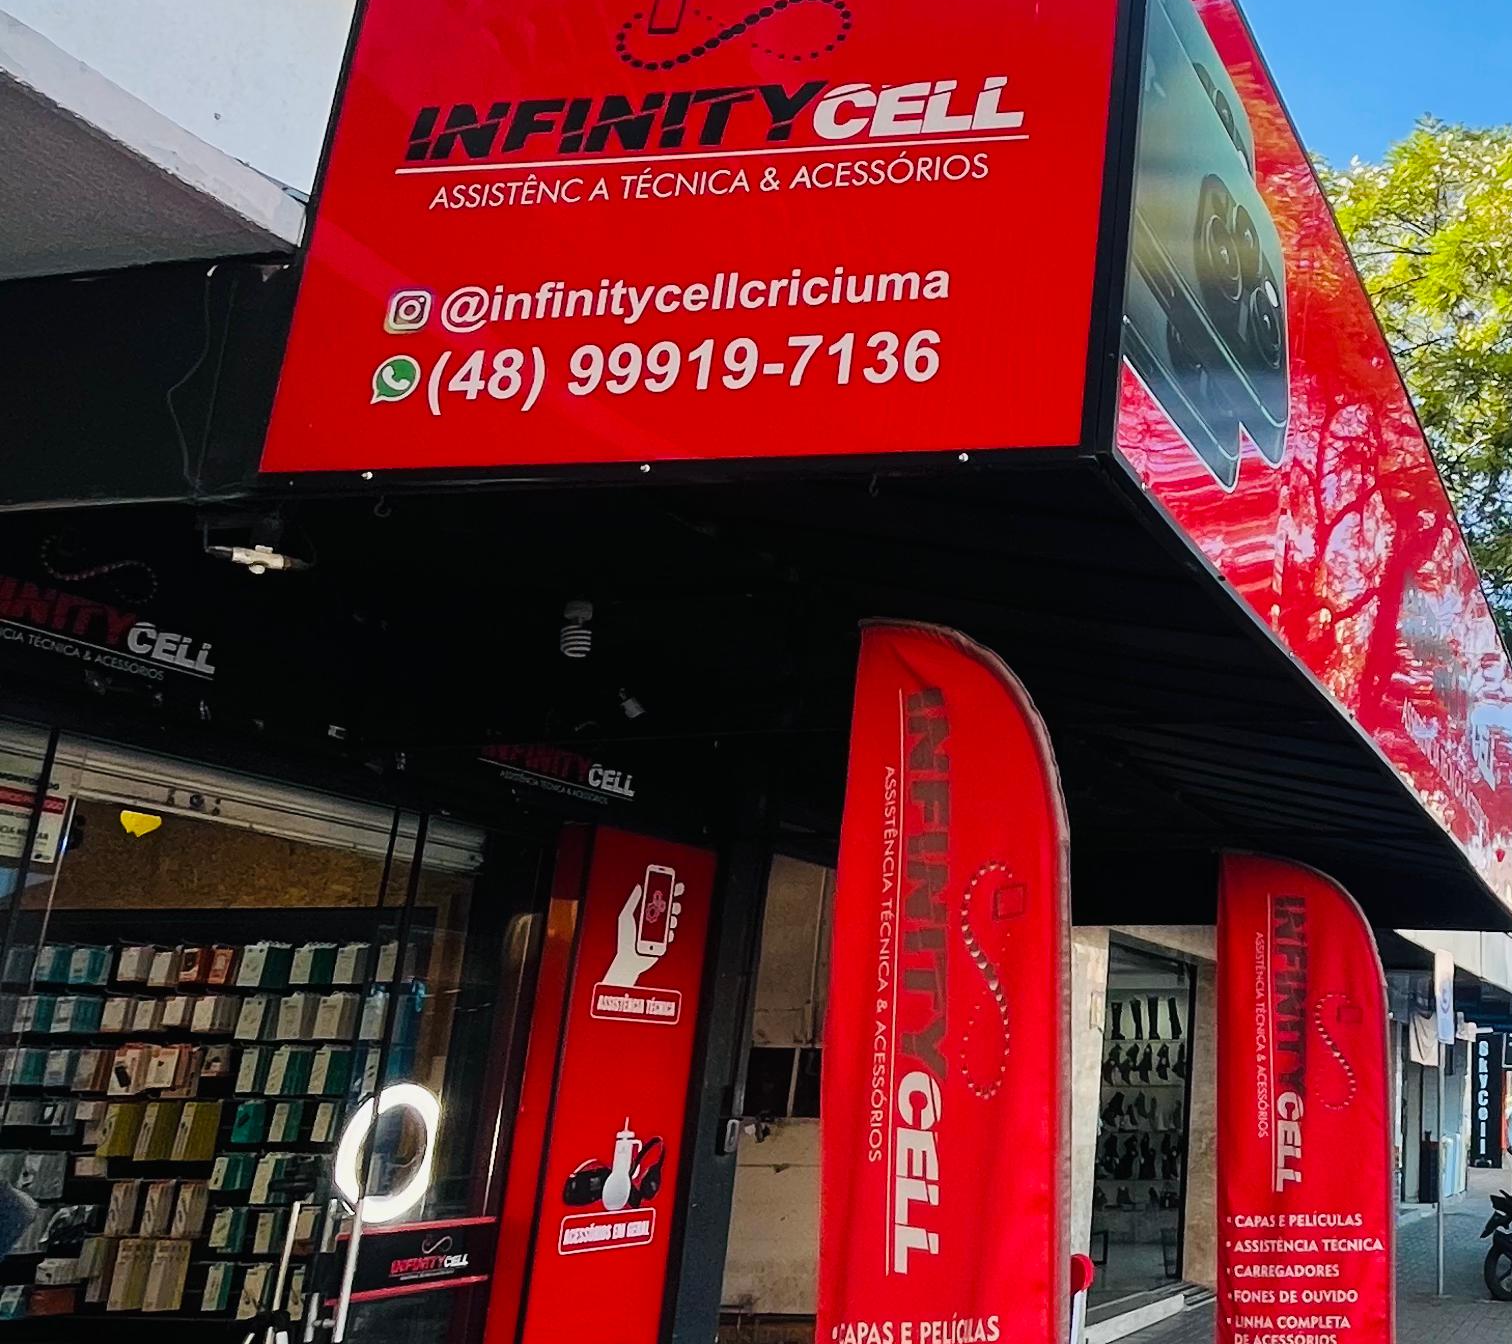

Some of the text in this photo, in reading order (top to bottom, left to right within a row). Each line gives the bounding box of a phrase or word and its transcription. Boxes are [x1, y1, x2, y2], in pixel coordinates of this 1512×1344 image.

[620, 166, 750, 201] TÉCNICA
[759, 166, 781, 193] &
[788, 151, 990, 191] ACESSÓRIOS
[440, 265, 951, 334] @infinitycellcriciuma
[427, 328, 942, 417] (48) 99919-7136
[868, 766, 898, 1163] ASSISTÊNCIA TÉCNICA & ACESSÓRIOS
[1234, 1210, 1363, 1228] CAPAS E PELÍCULAS
[1233, 1235, 1385, 1253] ASSISTÊNCIA TÉCNICA
[1233, 1264, 1340, 1278] CARREGADORES
[1233, 1289, 1359, 1304] FONES DE OUVIDO
[1235, 1315, 1351, 1330] LINHA COMPLETA
